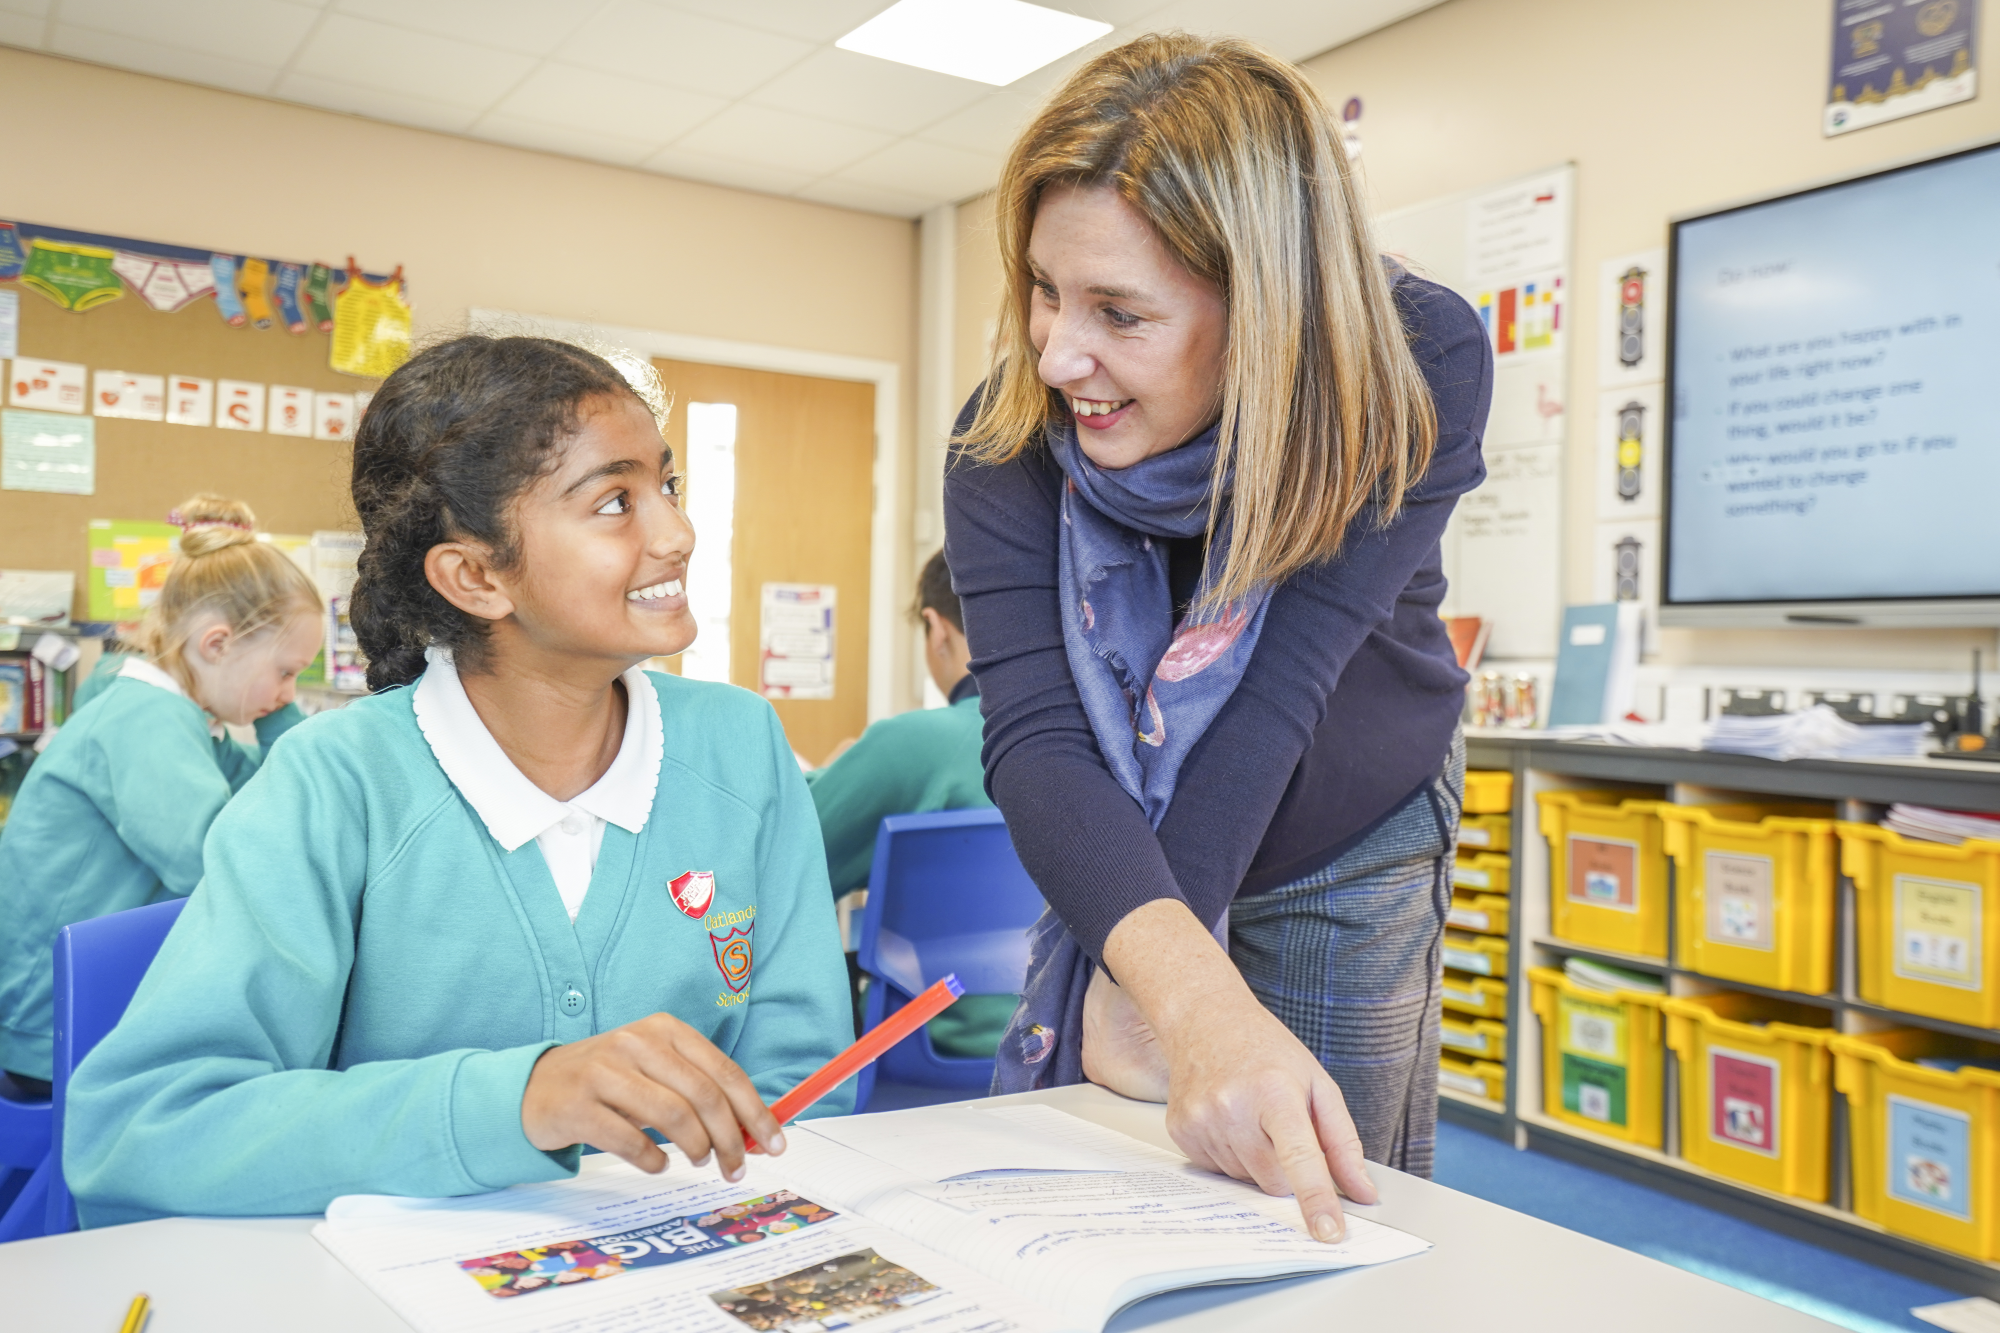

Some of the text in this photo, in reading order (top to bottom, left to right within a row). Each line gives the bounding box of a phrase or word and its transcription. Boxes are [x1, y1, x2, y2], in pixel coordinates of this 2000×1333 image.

[1730, 313, 1961, 362] What are you happy with in
[1728, 347, 1885, 391] your life right now?
[1742, 399, 1770, 417] you
[1774, 390, 1818, 411] could
[1822, 382, 1882, 405] change
[1886, 379, 1922, 396] one
[1774, 414, 1824, 435] would
[1845, 405, 1877, 427] be?
[1767, 446, 1816, 465] would
[1819, 446, 1850, 465] you
[1854, 443, 1876, 462] go
[1877, 438, 1899, 456] to
[1920, 433, 1956, 456] you
[1724, 468, 1868, 494] wanted to change
[1724, 492, 1817, 517] something?
[729, 945, 747, 974] S
[588, 1218, 682, 1247] AMBITION
[597, 1226, 710, 1260] BIG
[680, 1240, 724, 1255] THE
